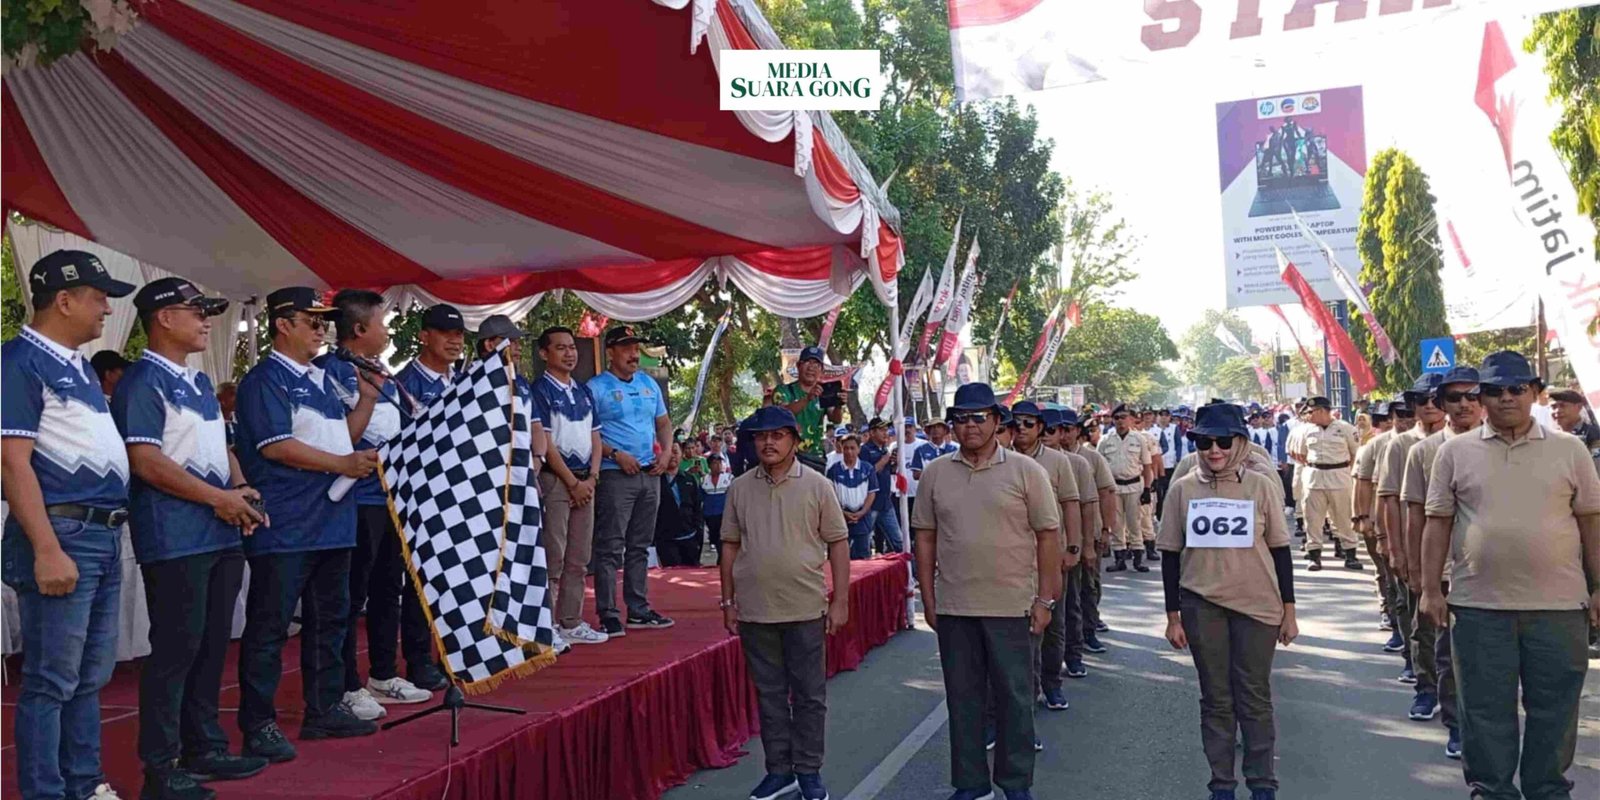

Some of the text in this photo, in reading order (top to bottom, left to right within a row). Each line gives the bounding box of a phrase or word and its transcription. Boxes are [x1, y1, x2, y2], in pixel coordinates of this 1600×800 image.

[1255, 223, 1292, 234] POWERFUL
[1233, 235, 1253, 244] WITH
[1254, 234, 1274, 242] MOST
[1274, 231, 1303, 240] COOLES
[1192, 516, 1248, 536] 062
